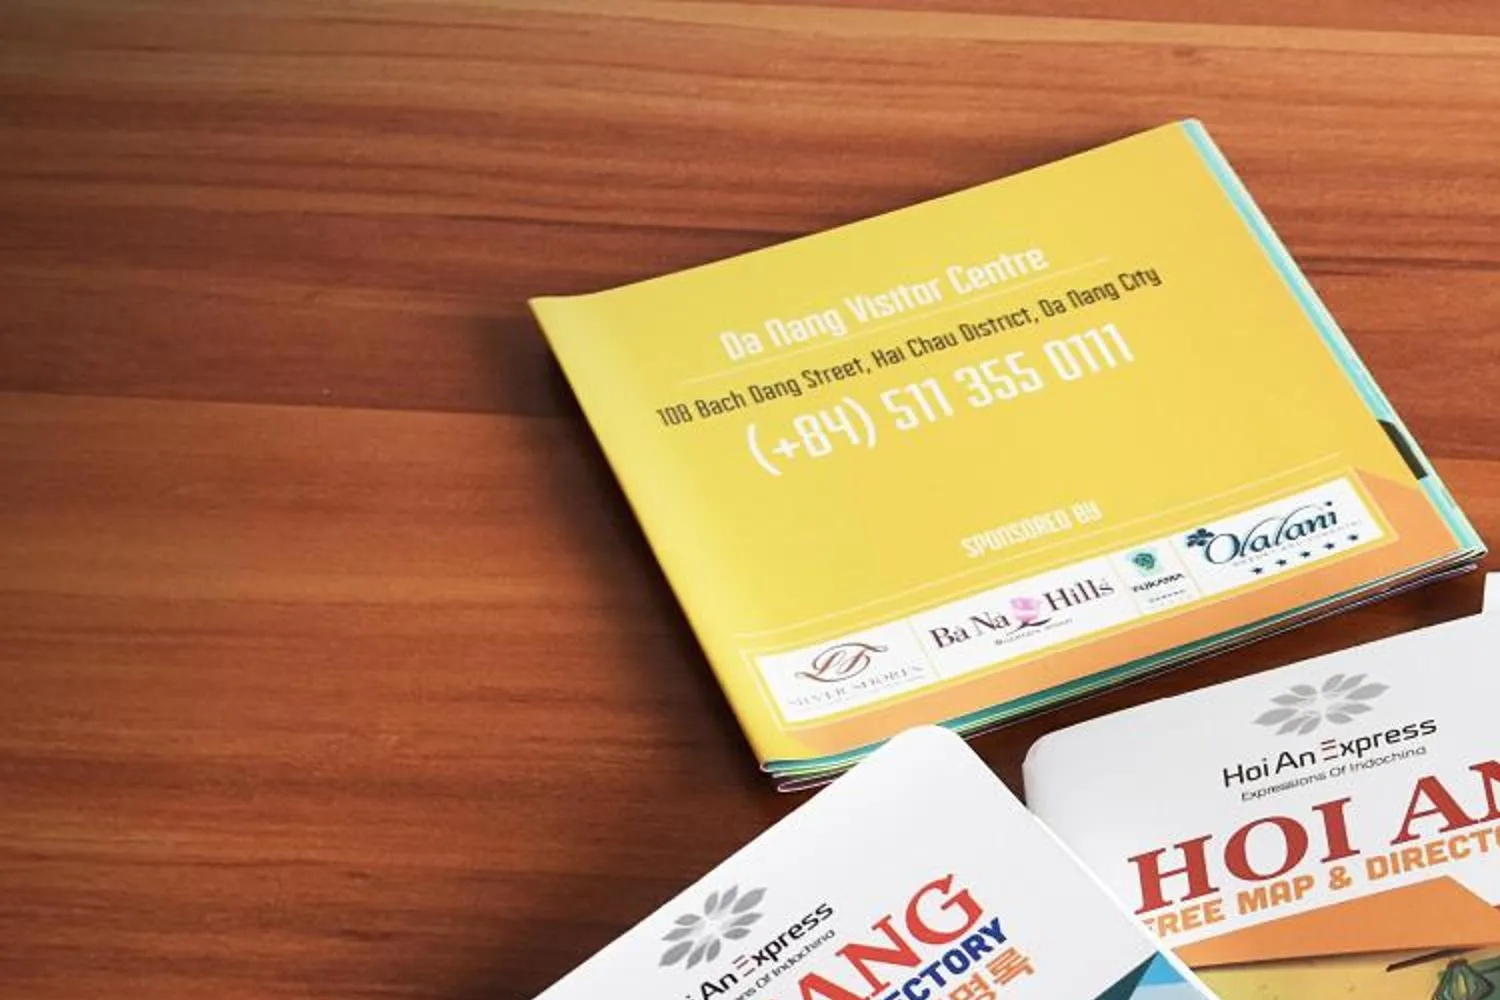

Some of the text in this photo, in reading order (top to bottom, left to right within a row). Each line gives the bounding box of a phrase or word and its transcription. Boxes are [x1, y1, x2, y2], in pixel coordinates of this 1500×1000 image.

[719, 247, 1048, 363] Da Nang Visitor Centre
[656, 266, 1163, 427] 108 Bach Dang Street, Hai Chau District, Da Nang City
[746, 323, 1136, 477] (+84) 511 355 0111
[960, 502, 1101, 560] SPONSORED BY
[1042, 572, 1115, 613] Hills
[1223, 719, 1438, 788] Hoi An Express
[1241, 746, 1427, 802] Expressions Of Indochina
[1127, 797, 1361, 916] HOI
[1237, 874, 1315, 915] MAP
[1328, 866, 1352, 890] &
[732, 902, 835, 978] Express
[755, 975, 772, 990] Of
[771, 930, 836, 980] Indochina
